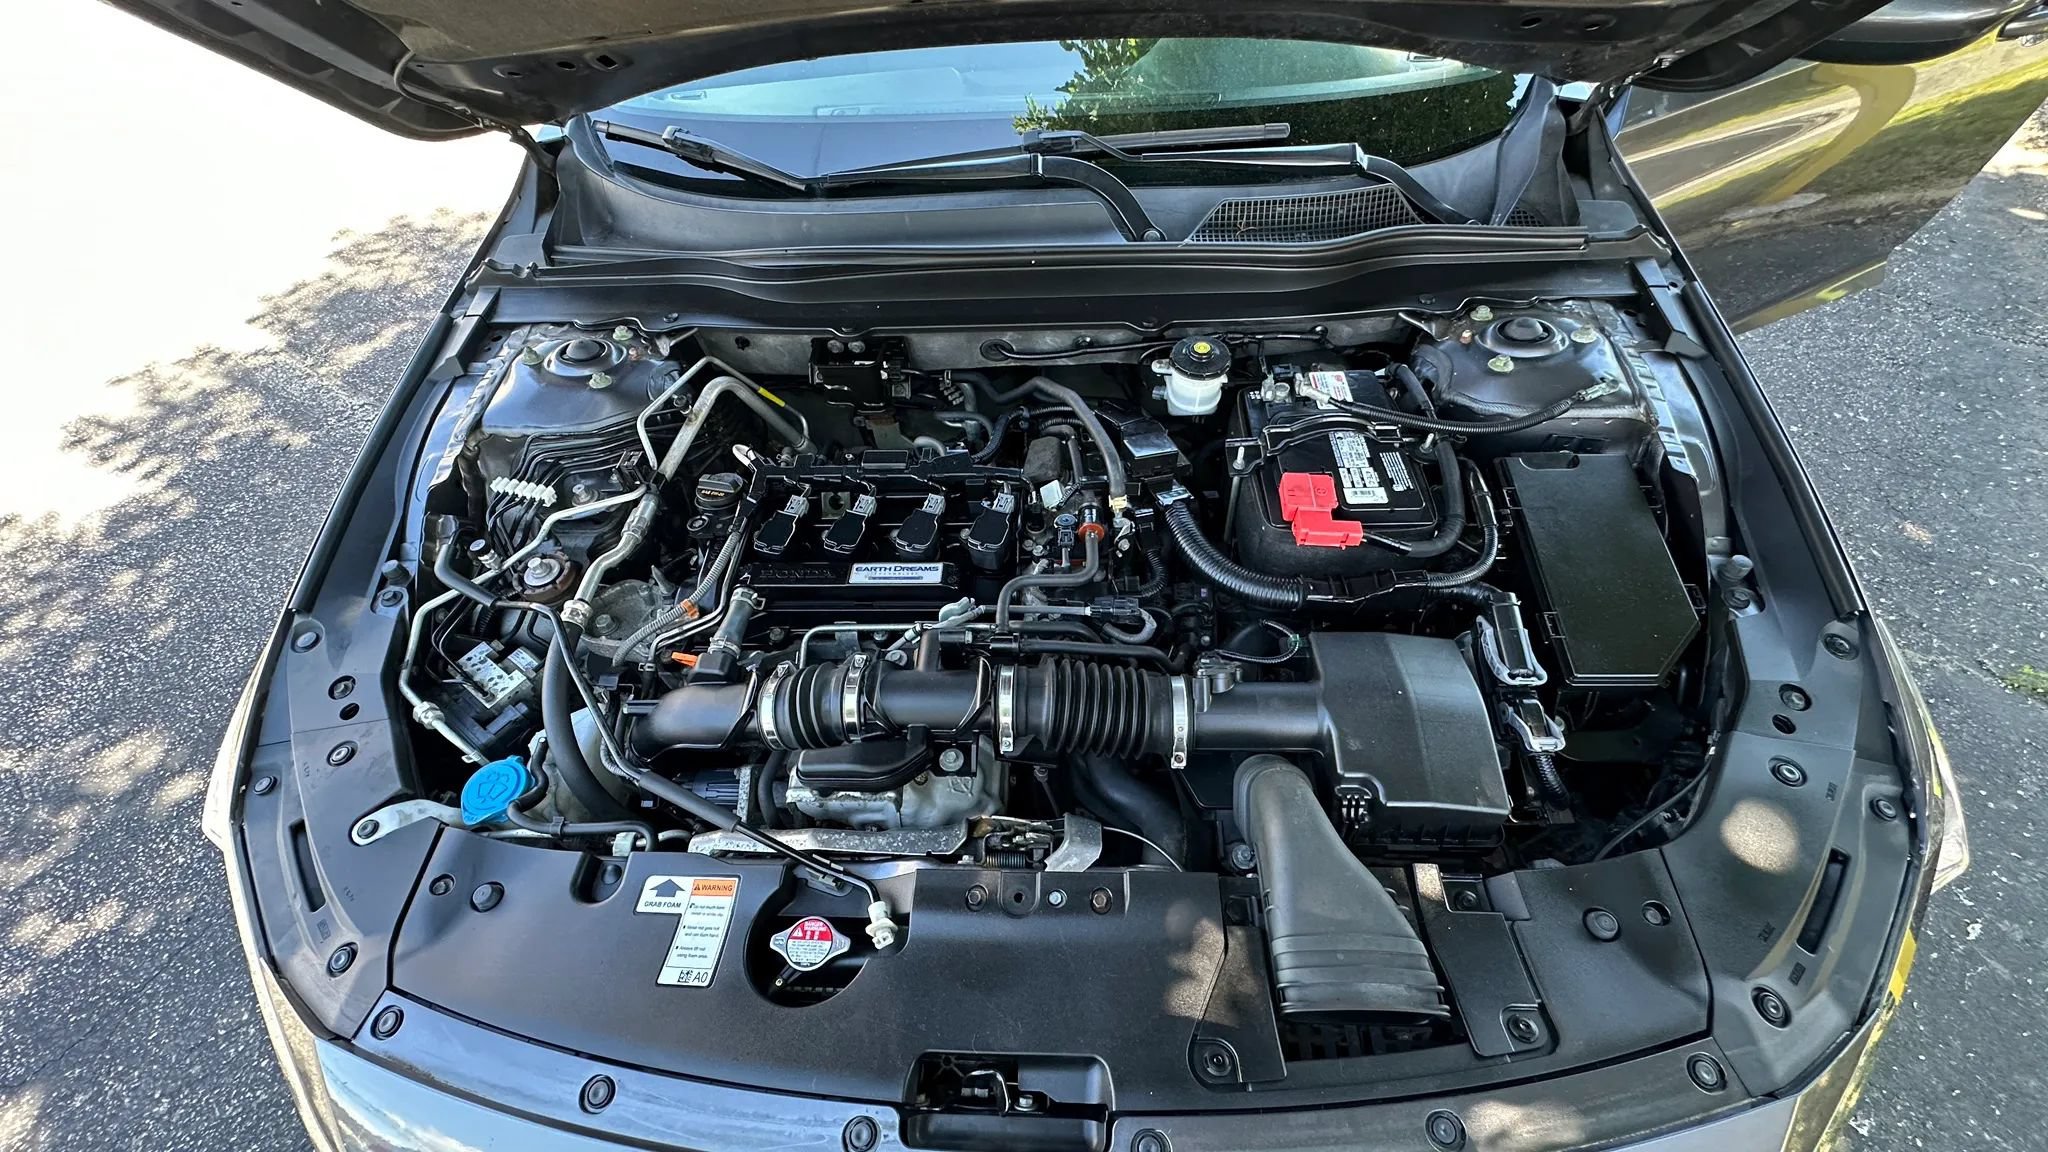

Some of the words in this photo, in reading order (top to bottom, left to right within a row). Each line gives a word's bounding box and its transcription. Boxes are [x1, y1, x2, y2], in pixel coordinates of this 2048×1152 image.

[701, 884, 733, 892] WARNING
[644, 900, 662, 908] GRAB
[692, 971, 709, 983] A0
